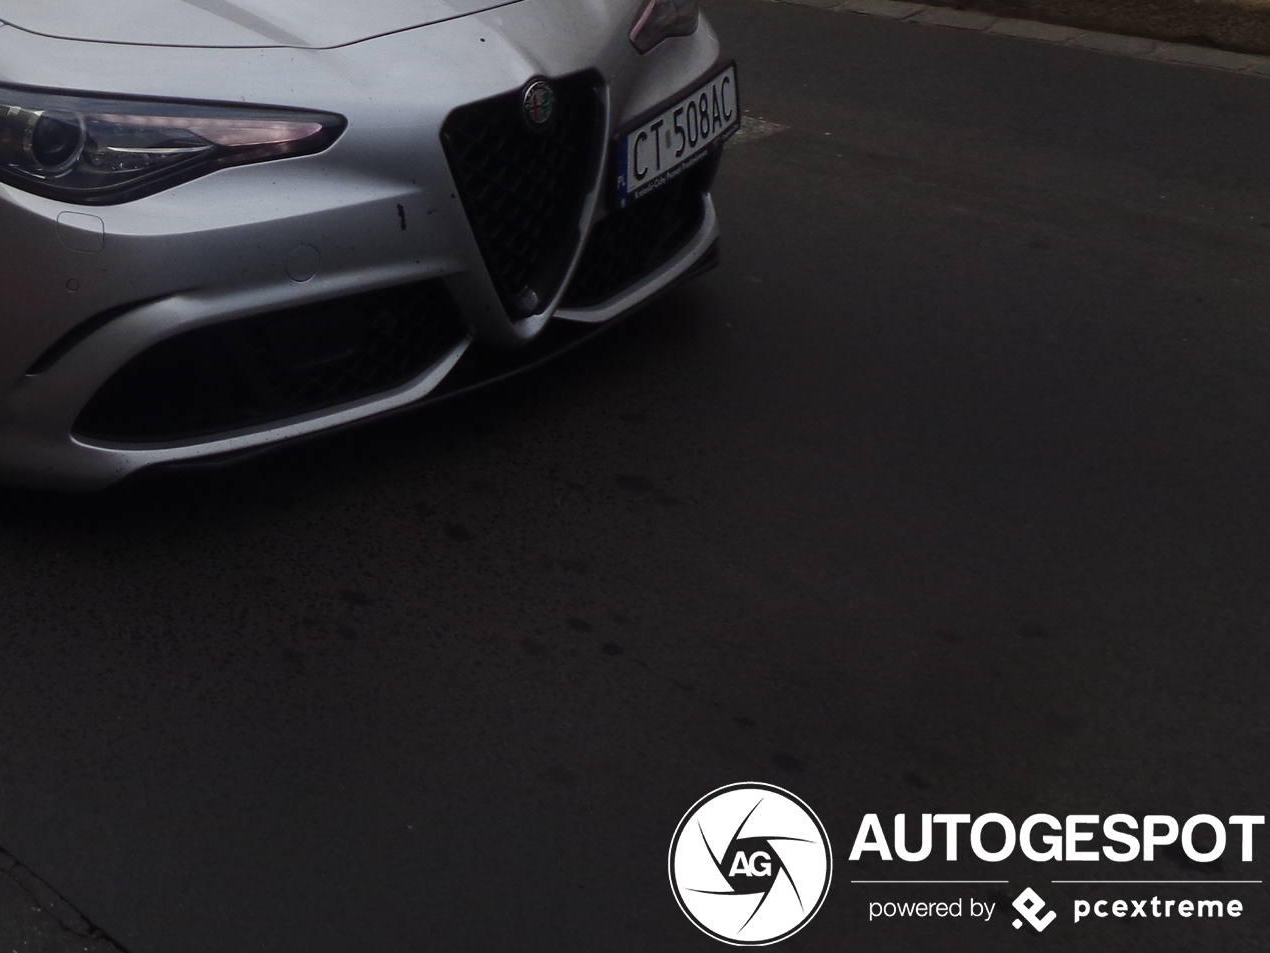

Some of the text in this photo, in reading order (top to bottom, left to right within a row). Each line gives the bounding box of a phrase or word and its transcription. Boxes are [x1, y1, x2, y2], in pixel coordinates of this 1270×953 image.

[633, 119, 664, 181] CT
[673, 76, 733, 158] 508AC
[617, 175, 626, 189] PL
